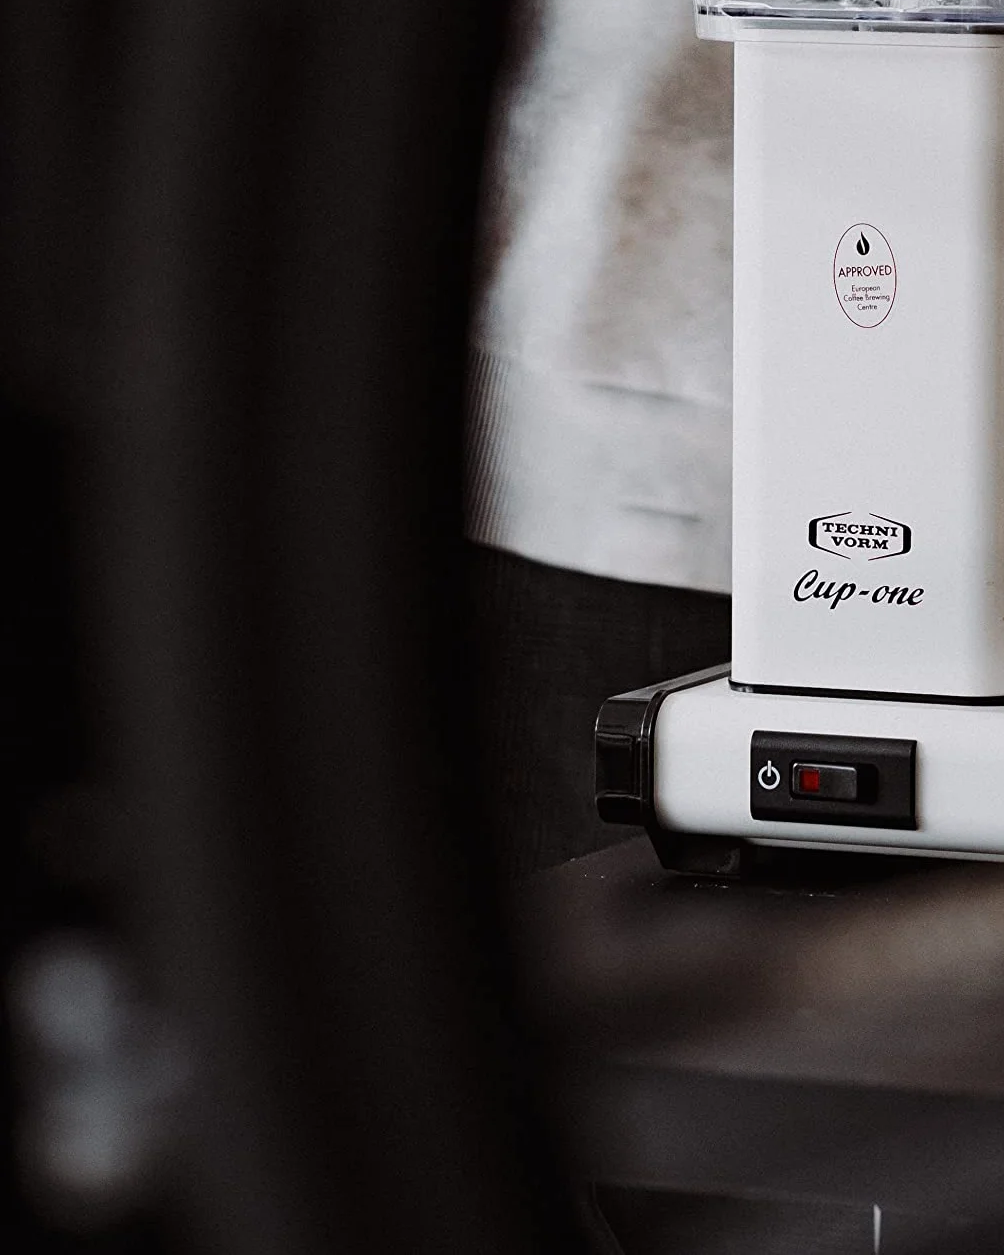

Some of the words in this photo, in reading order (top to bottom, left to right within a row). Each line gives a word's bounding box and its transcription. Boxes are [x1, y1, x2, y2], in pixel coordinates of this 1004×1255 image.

[838, 264, 893, 278] APPROVED
[851, 284, 881, 294] European
[843, 294, 864, 302] Coffee
[865, 293, 891, 302] Brewing
[857, 303, 878, 312] Centre
[822, 522, 899, 538] TECHNI
[830, 535, 889, 550] VORM
[793, 569, 925, 610] Cup-one
